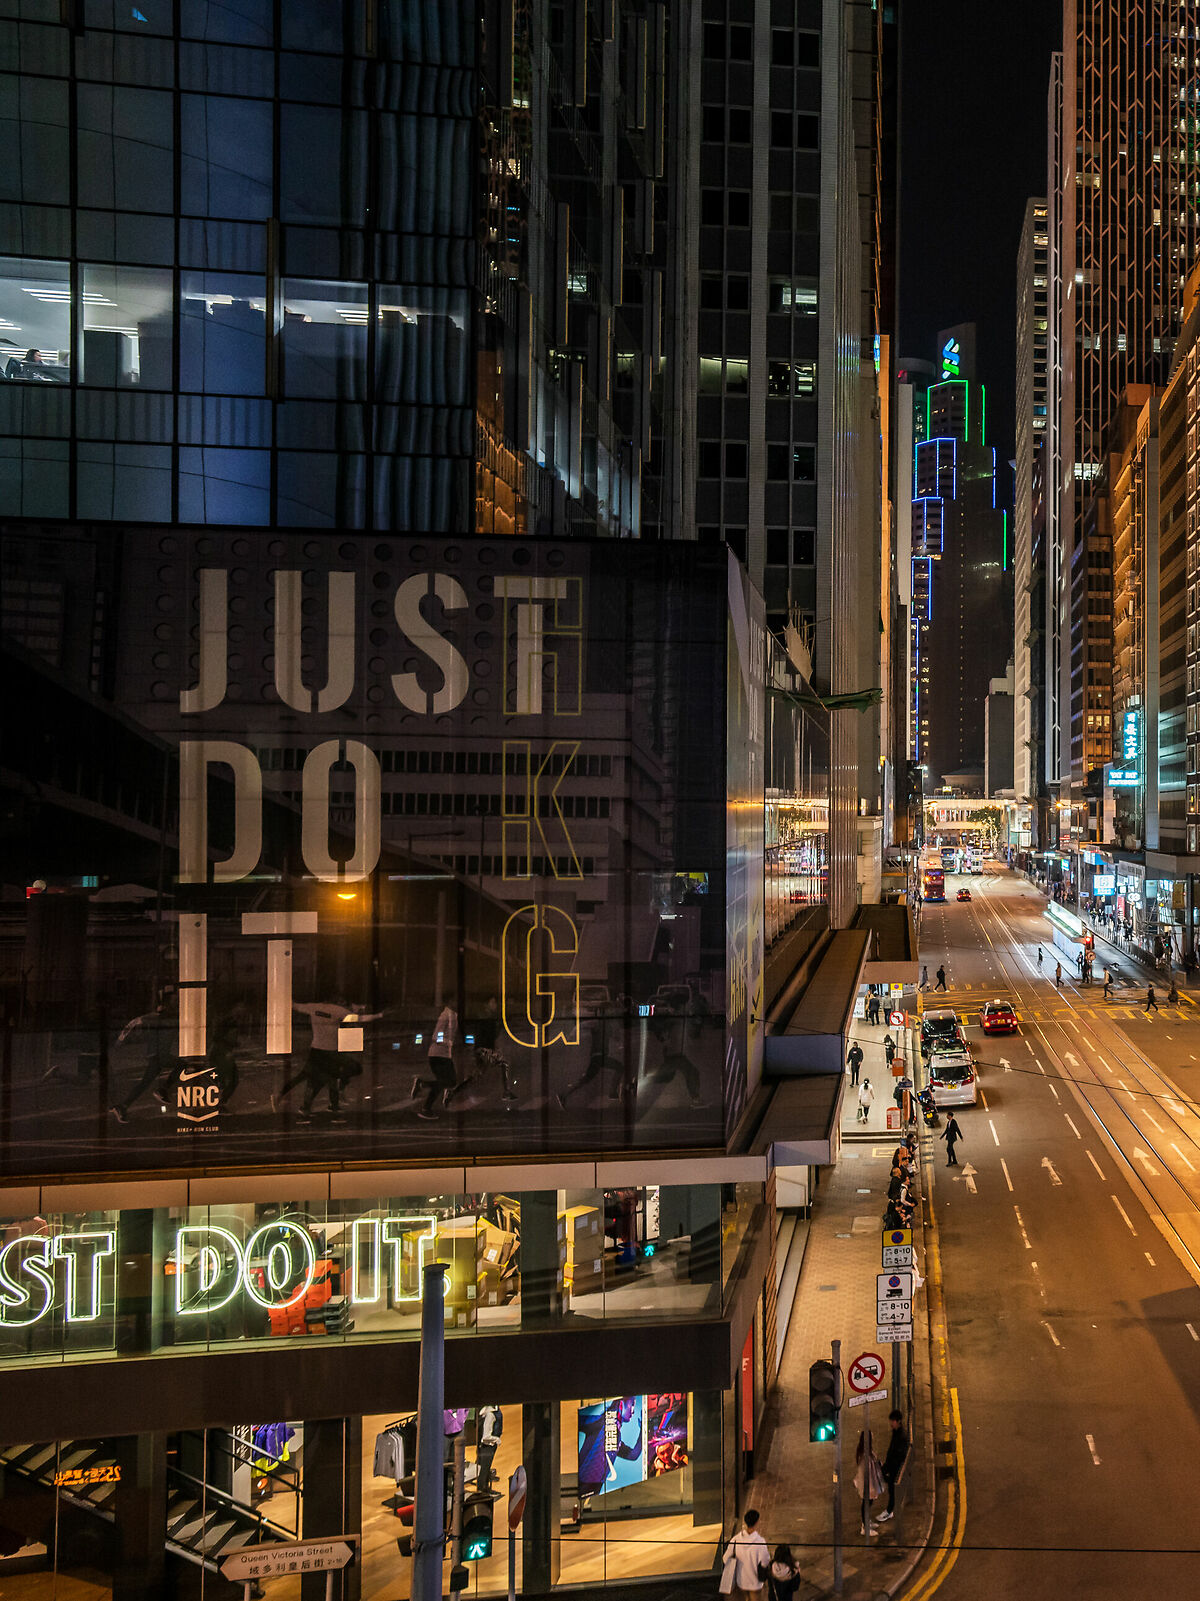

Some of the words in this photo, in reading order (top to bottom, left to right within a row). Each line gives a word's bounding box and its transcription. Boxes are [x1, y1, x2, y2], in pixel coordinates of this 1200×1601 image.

[180, 568, 567, 715] JUST
[179, 739, 381, 883] DO
[177, 1086, 219, 1107] NRC
[175, 1219, 316, 1314] DO
[890, 1302, 910, 1310] 8-10
[240, 1554, 269, 1564] Queen
[271, 1551, 304, 1560] Victoria
[306, 1546, 333, 1556] Street
[249, 1559, 324, 1575] 域多利皇后街
